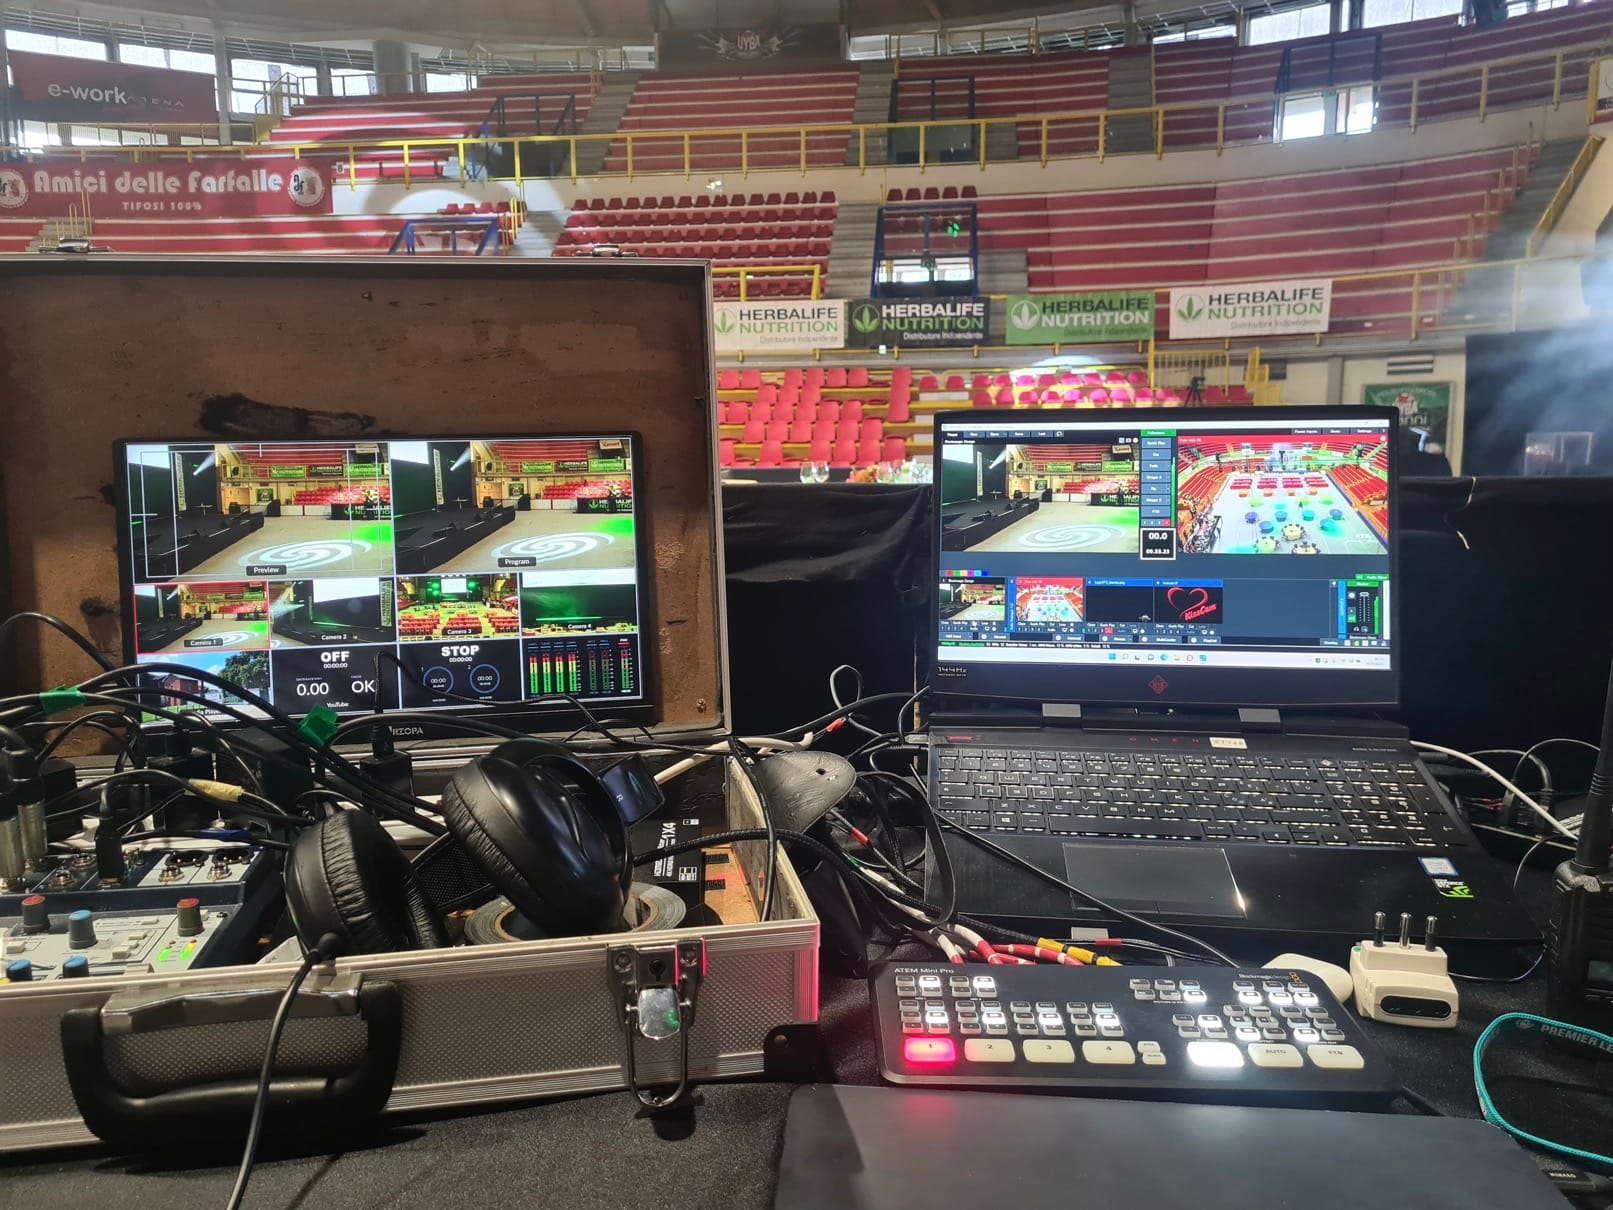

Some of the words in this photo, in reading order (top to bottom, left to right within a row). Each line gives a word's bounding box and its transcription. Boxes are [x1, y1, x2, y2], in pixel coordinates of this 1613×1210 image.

[47, 83, 127, 104] e-work
[34, 169, 107, 193] Amici
[114, 170, 181, 193] delle
[122, 201, 164, 211] TIFOSI
[170, 201, 202, 211] 100%
[1208, 287, 1324, 306] HERBALIFE
[881, 303, 985, 317] HERBALIFE
[1042, 298, 1149, 313] HERBALIFE
[1208, 302, 1324, 320] NUTRITION
[740, 307, 838, 320] HERBALIFE
[1041, 311, 1149, 327] NUTRITION
[740, 320, 838, 334] NUTRITION
[881, 317, 984, 331] NUTRITION
[504, 557, 530, 567] Program
[253, 565, 280, 574] Preview
[320, 651, 350, 662] OFF
[441, 645, 479, 656] STOP
[296, 682, 329, 696] 0.00
[351, 680, 376, 693] OK
[1540, 1024, 1599, 1046] PREMIER
